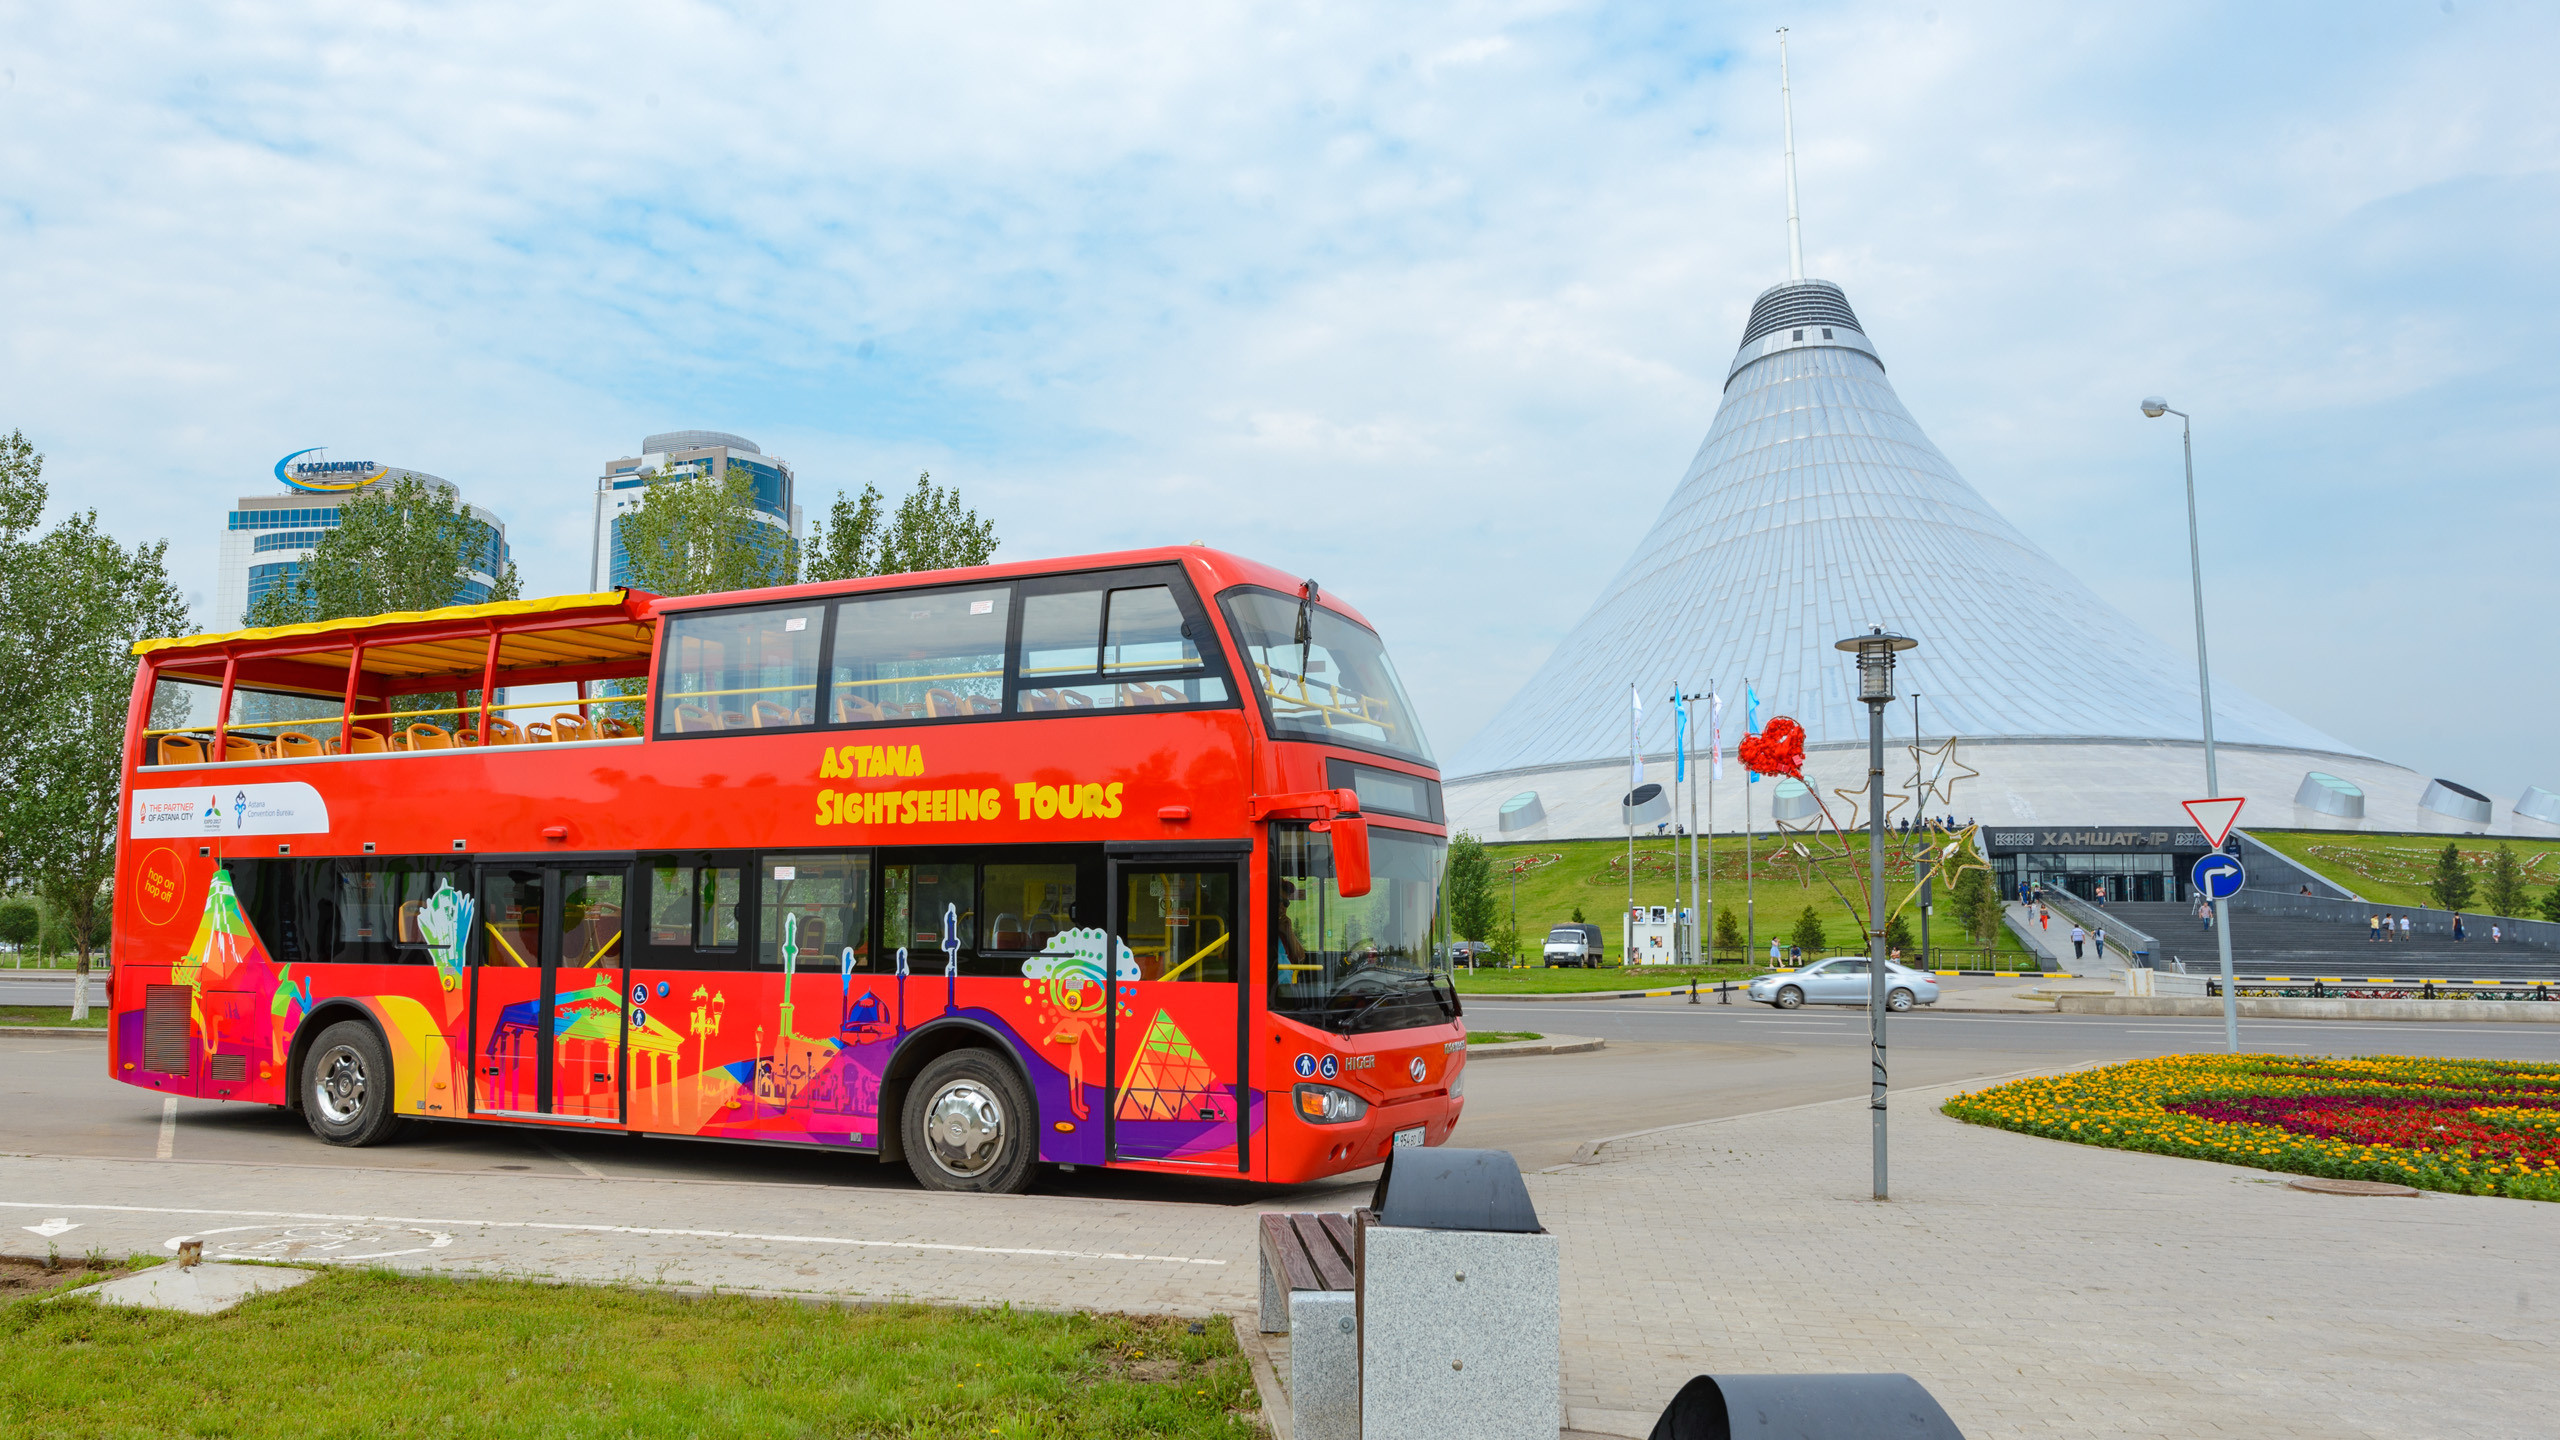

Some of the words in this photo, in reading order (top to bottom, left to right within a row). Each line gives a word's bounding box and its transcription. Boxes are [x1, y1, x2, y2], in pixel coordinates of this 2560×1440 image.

[297, 461, 375, 473] KAZAKHMYS
[819, 744, 925, 779] ASTANA
[149, 804, 162, 813] THE
[163, 802, 194, 812] PARTNER
[815, 787, 1001, 826] SIGHTSEEING
[1014, 781, 1124, 821] TOURS
[148, 814, 157, 822] OF
[157, 813, 180, 821] ASTANA
[180, 812, 194, 821] CITY
[247, 809, 276, 818] Convention
[276, 808, 294, 817] Bureau
[147, 867, 163, 886] hop
[164, 879, 175, 891] on
[144, 879, 160, 899] hop
[160, 891, 173, 903] off
[1345, 1054, 1375, 1071] HIGER
